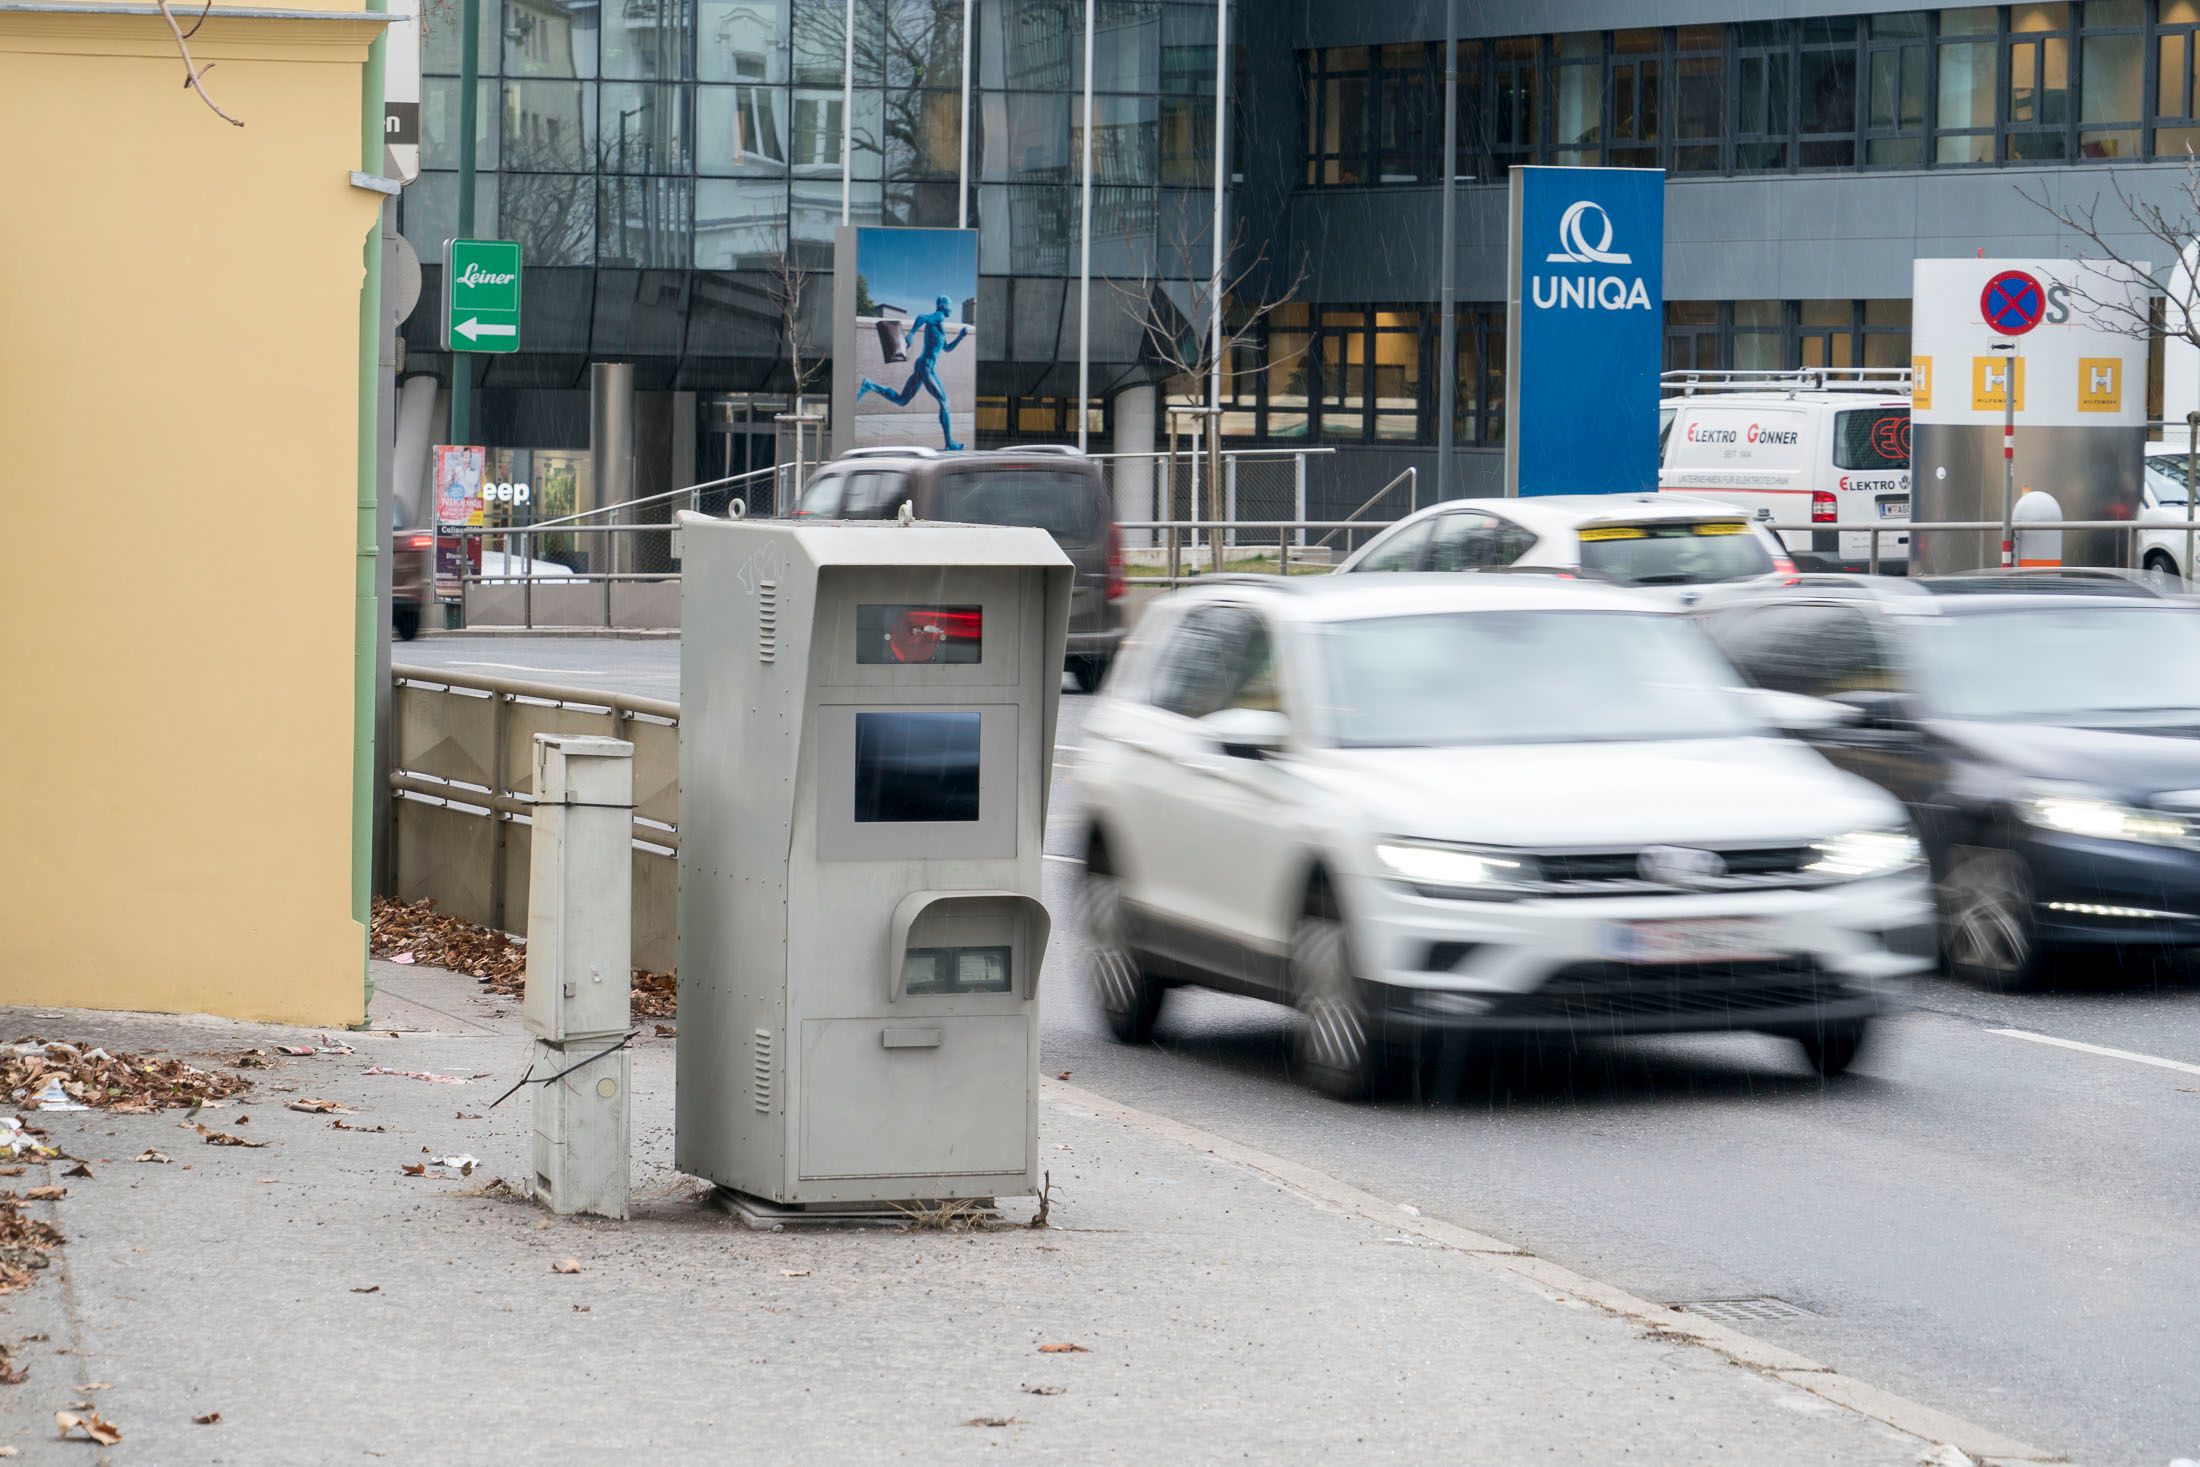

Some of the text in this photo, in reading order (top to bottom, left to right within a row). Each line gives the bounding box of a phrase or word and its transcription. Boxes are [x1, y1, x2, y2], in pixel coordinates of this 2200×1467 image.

[457, 263, 516, 289] Leiner
[1532, 276, 1652, 310] UNIQA
[1687, 422, 1798, 445] ELEKTRO GÖNNER
[1839, 476, 1896, 491] ELEKTRO
